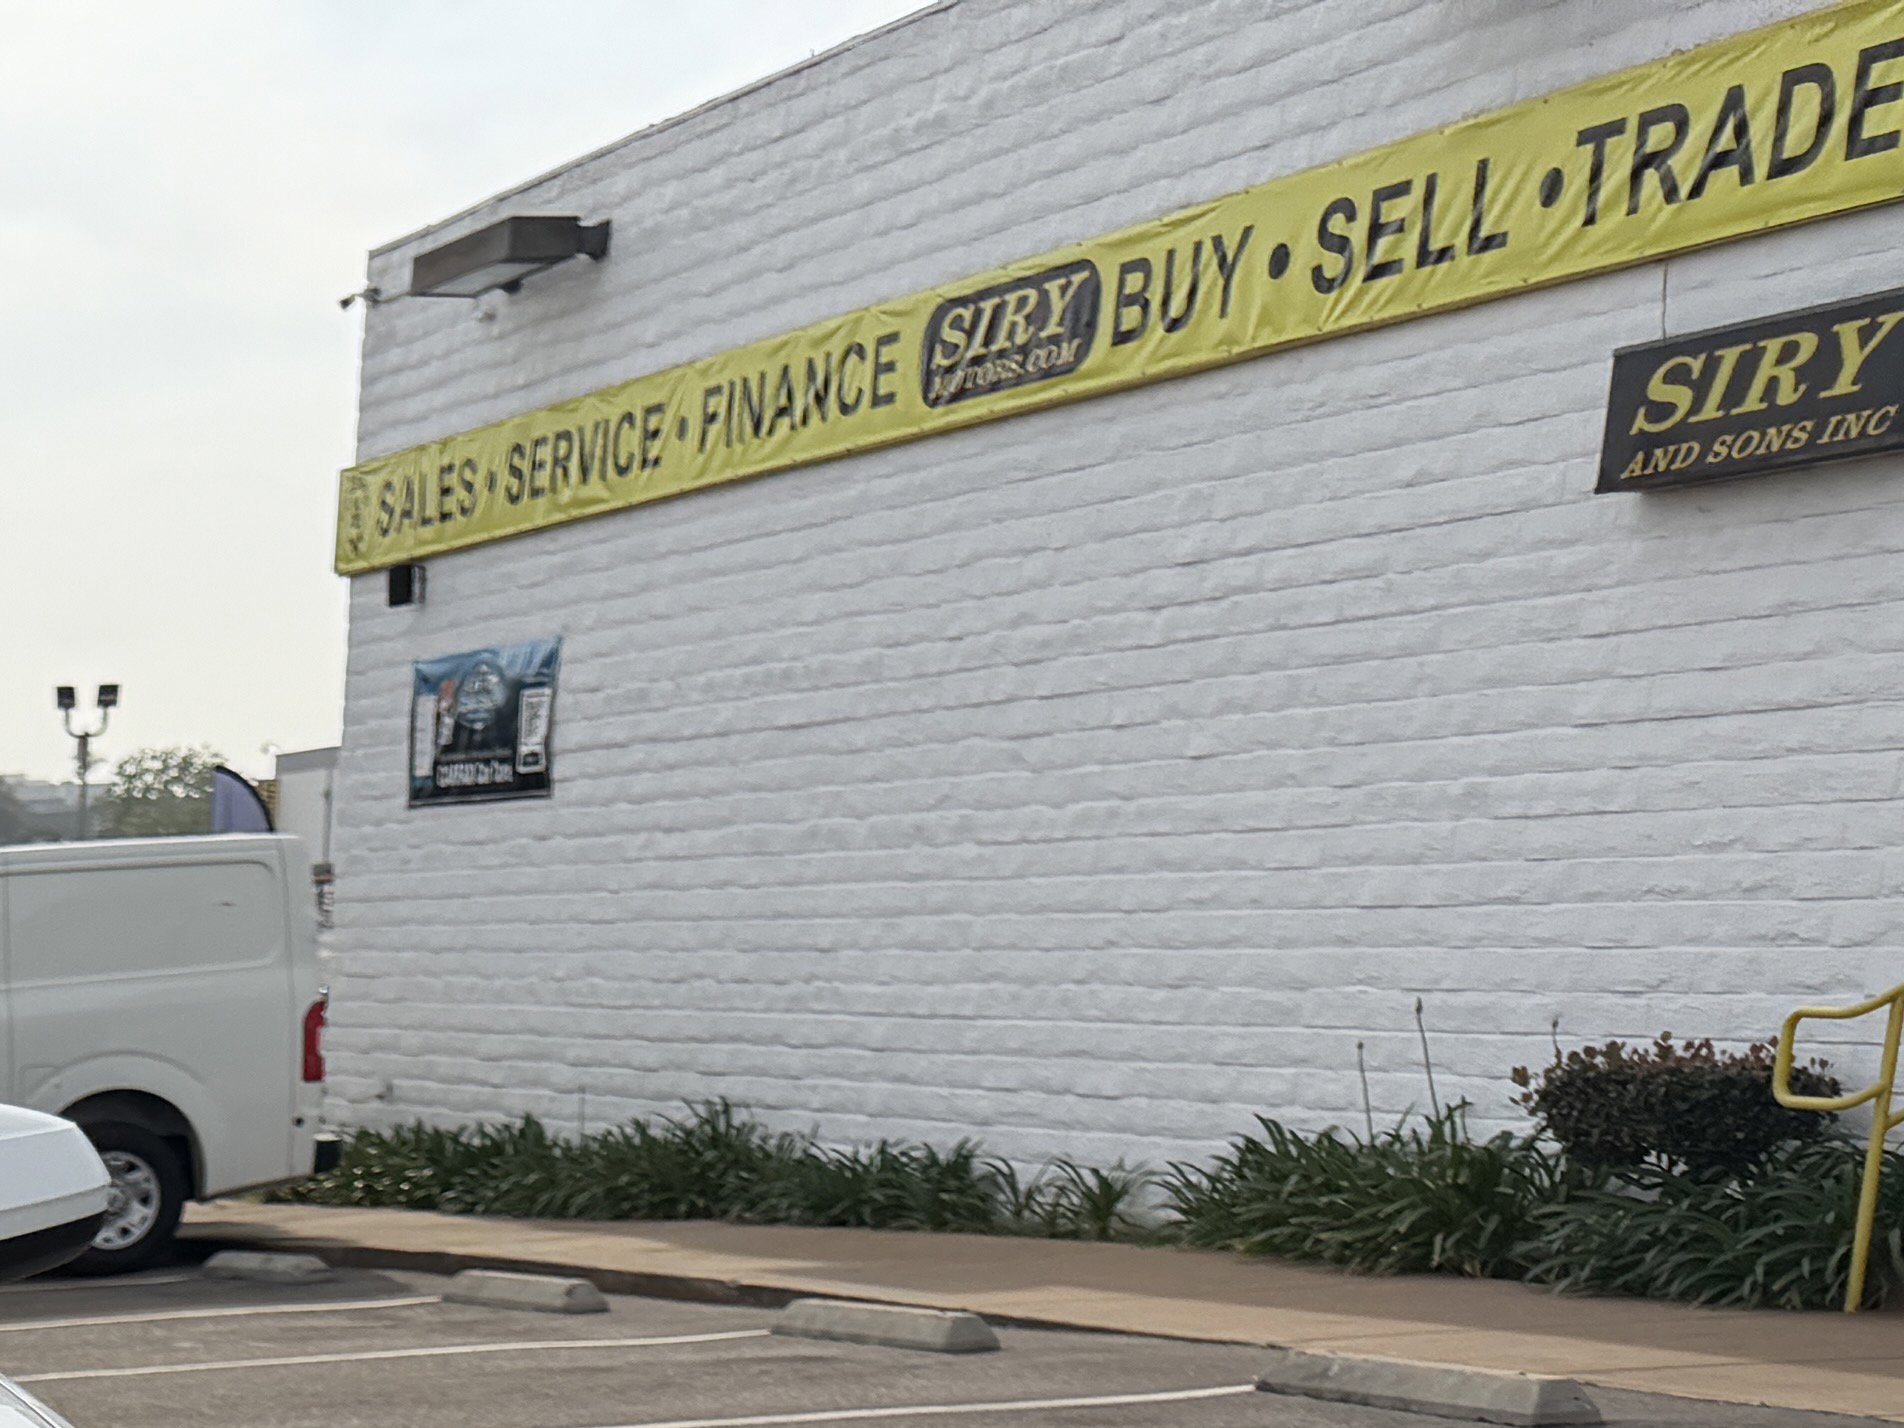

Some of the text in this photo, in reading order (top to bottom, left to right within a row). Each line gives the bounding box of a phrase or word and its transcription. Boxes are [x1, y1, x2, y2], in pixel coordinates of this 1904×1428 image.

[376, 458, 478, 538] SALES
[505, 402, 666, 505] SERVICE
[699, 331, 902, 453] FINANCE
[1111, 224, 1254, 347] BUY
[1310, 158, 1508, 294] SELL
[1576, 38, 1904, 228] TRADE
[930, 269, 1091, 371] SIRY
[1628, 313, 1904, 436] SIRY
[1620, 405, 1899, 481] AND SONS INC
